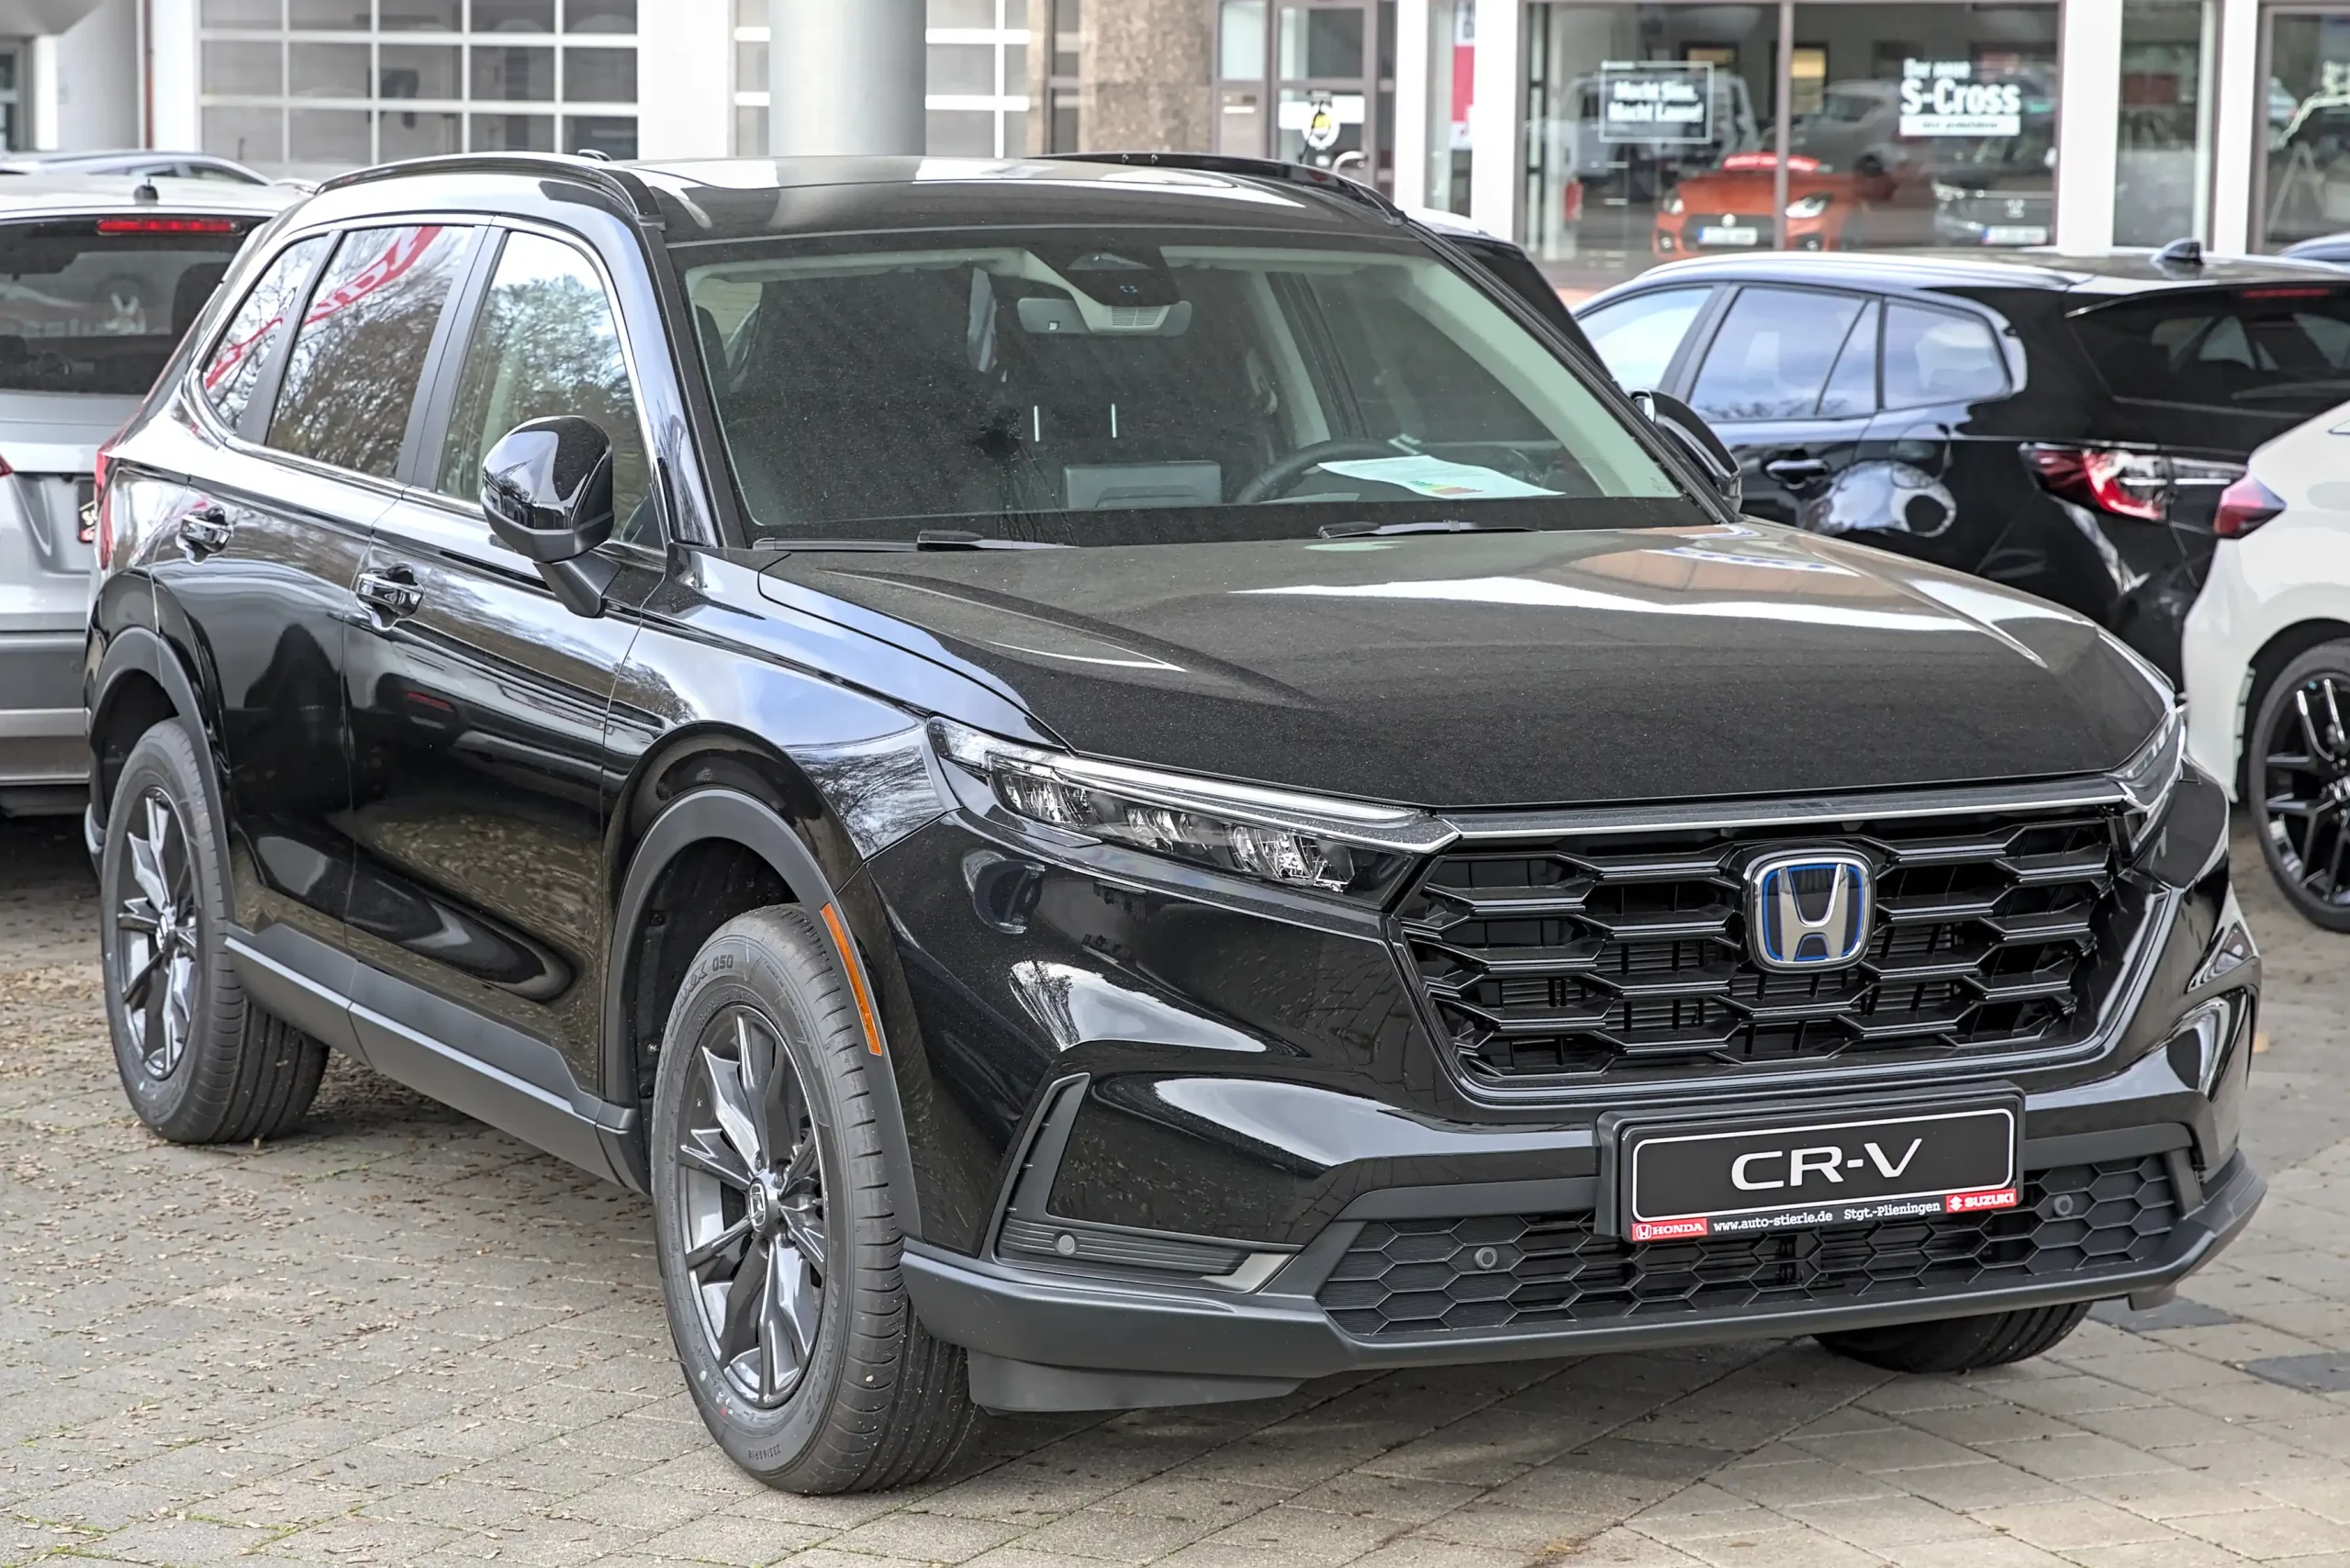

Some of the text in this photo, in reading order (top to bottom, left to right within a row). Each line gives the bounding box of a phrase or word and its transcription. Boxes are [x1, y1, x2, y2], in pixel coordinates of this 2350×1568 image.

[1900, 77, 2021, 116] S-Cross
[712, 954, 733, 972] 050
[1731, 1137, 1923, 1191] CR-V
[1964, 1193, 2015, 1208] SUZUKI
[1652, 1223, 1705, 1236] HONDA
[1713, 1201, 1942, 1233] www.auto-stierle.de Stgt.-Plieningen
